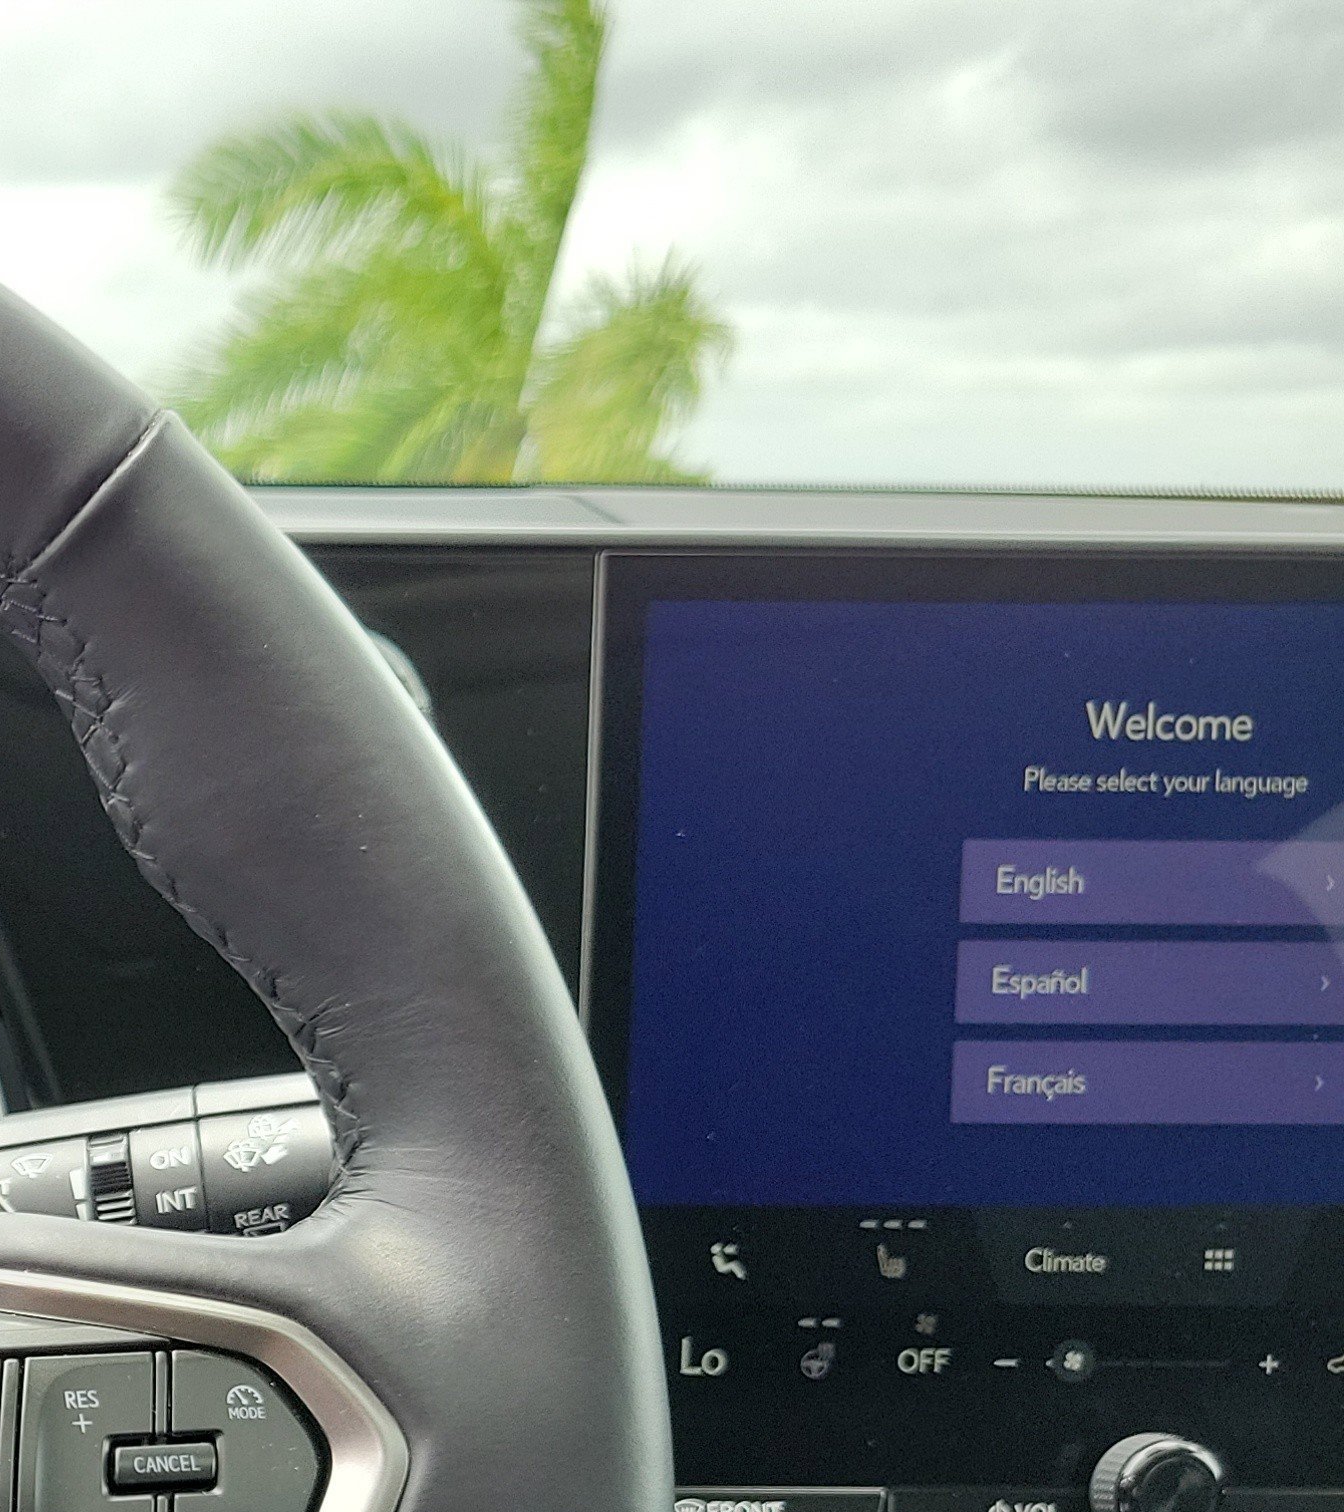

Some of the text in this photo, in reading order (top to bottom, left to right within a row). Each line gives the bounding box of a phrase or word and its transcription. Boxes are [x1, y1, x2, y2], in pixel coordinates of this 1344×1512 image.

[1085, 701, 1254, 742] Welcome
[1023, 766, 1308, 798] Please select your language
[995, 866, 1084, 900] English
[992, 967, 1088, 999] Español
[986, 1066, 1086, 1100] Français
[148, 1145, 189, 1169] ON
[155, 1189, 198, 1214] INT
[234, 1203, 291, 1229] REAR
[1024, 1246, 1106, 1273] Climate
[679, 1336, 728, 1376] Lo
[897, 1348, 952, 1373] OFF
[64, 1389, 99, 1409] RES
[227, 1407, 266, 1420] MODE
[133, 1455, 201, 1473] CANCEL
